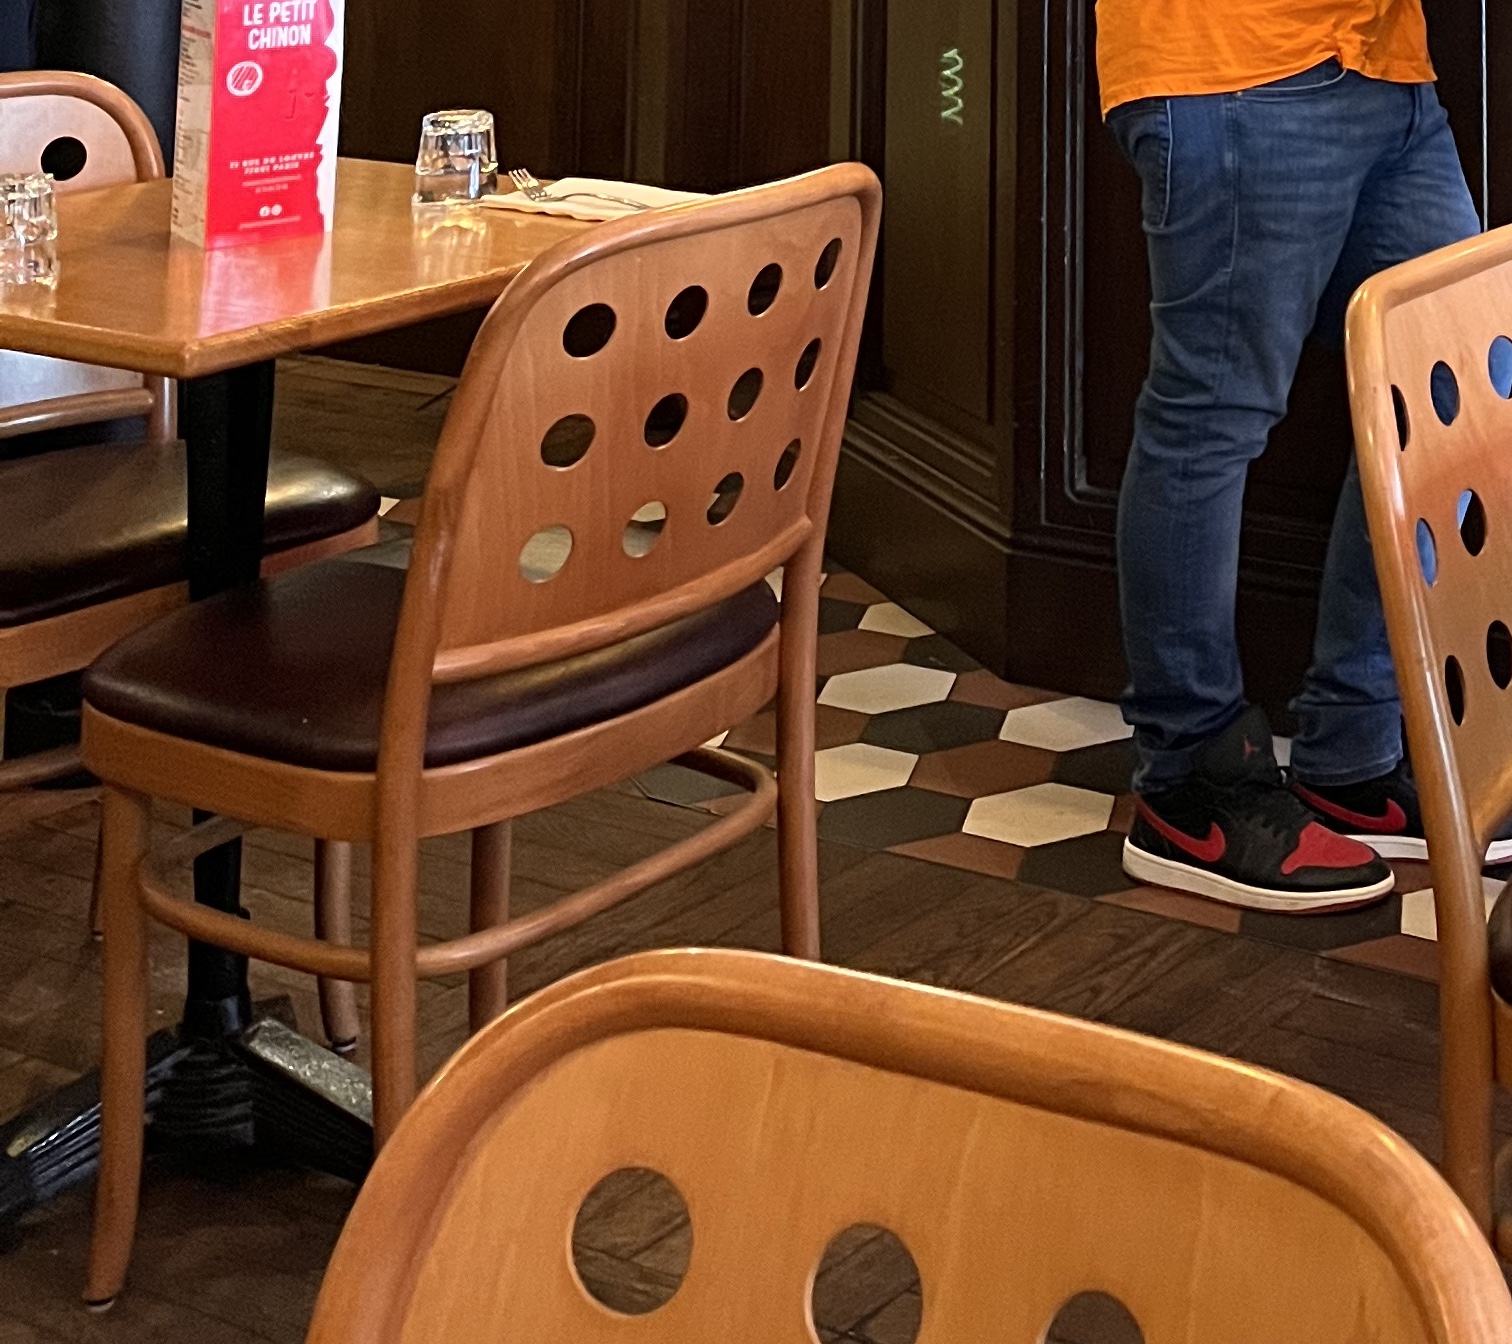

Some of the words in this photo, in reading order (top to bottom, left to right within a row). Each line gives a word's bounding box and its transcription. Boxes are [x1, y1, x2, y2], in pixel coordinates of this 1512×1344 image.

[243, 3, 264, 26] LE
[268, 0, 318, 23] PETIT
[248, 23, 311, 50] CHINON
